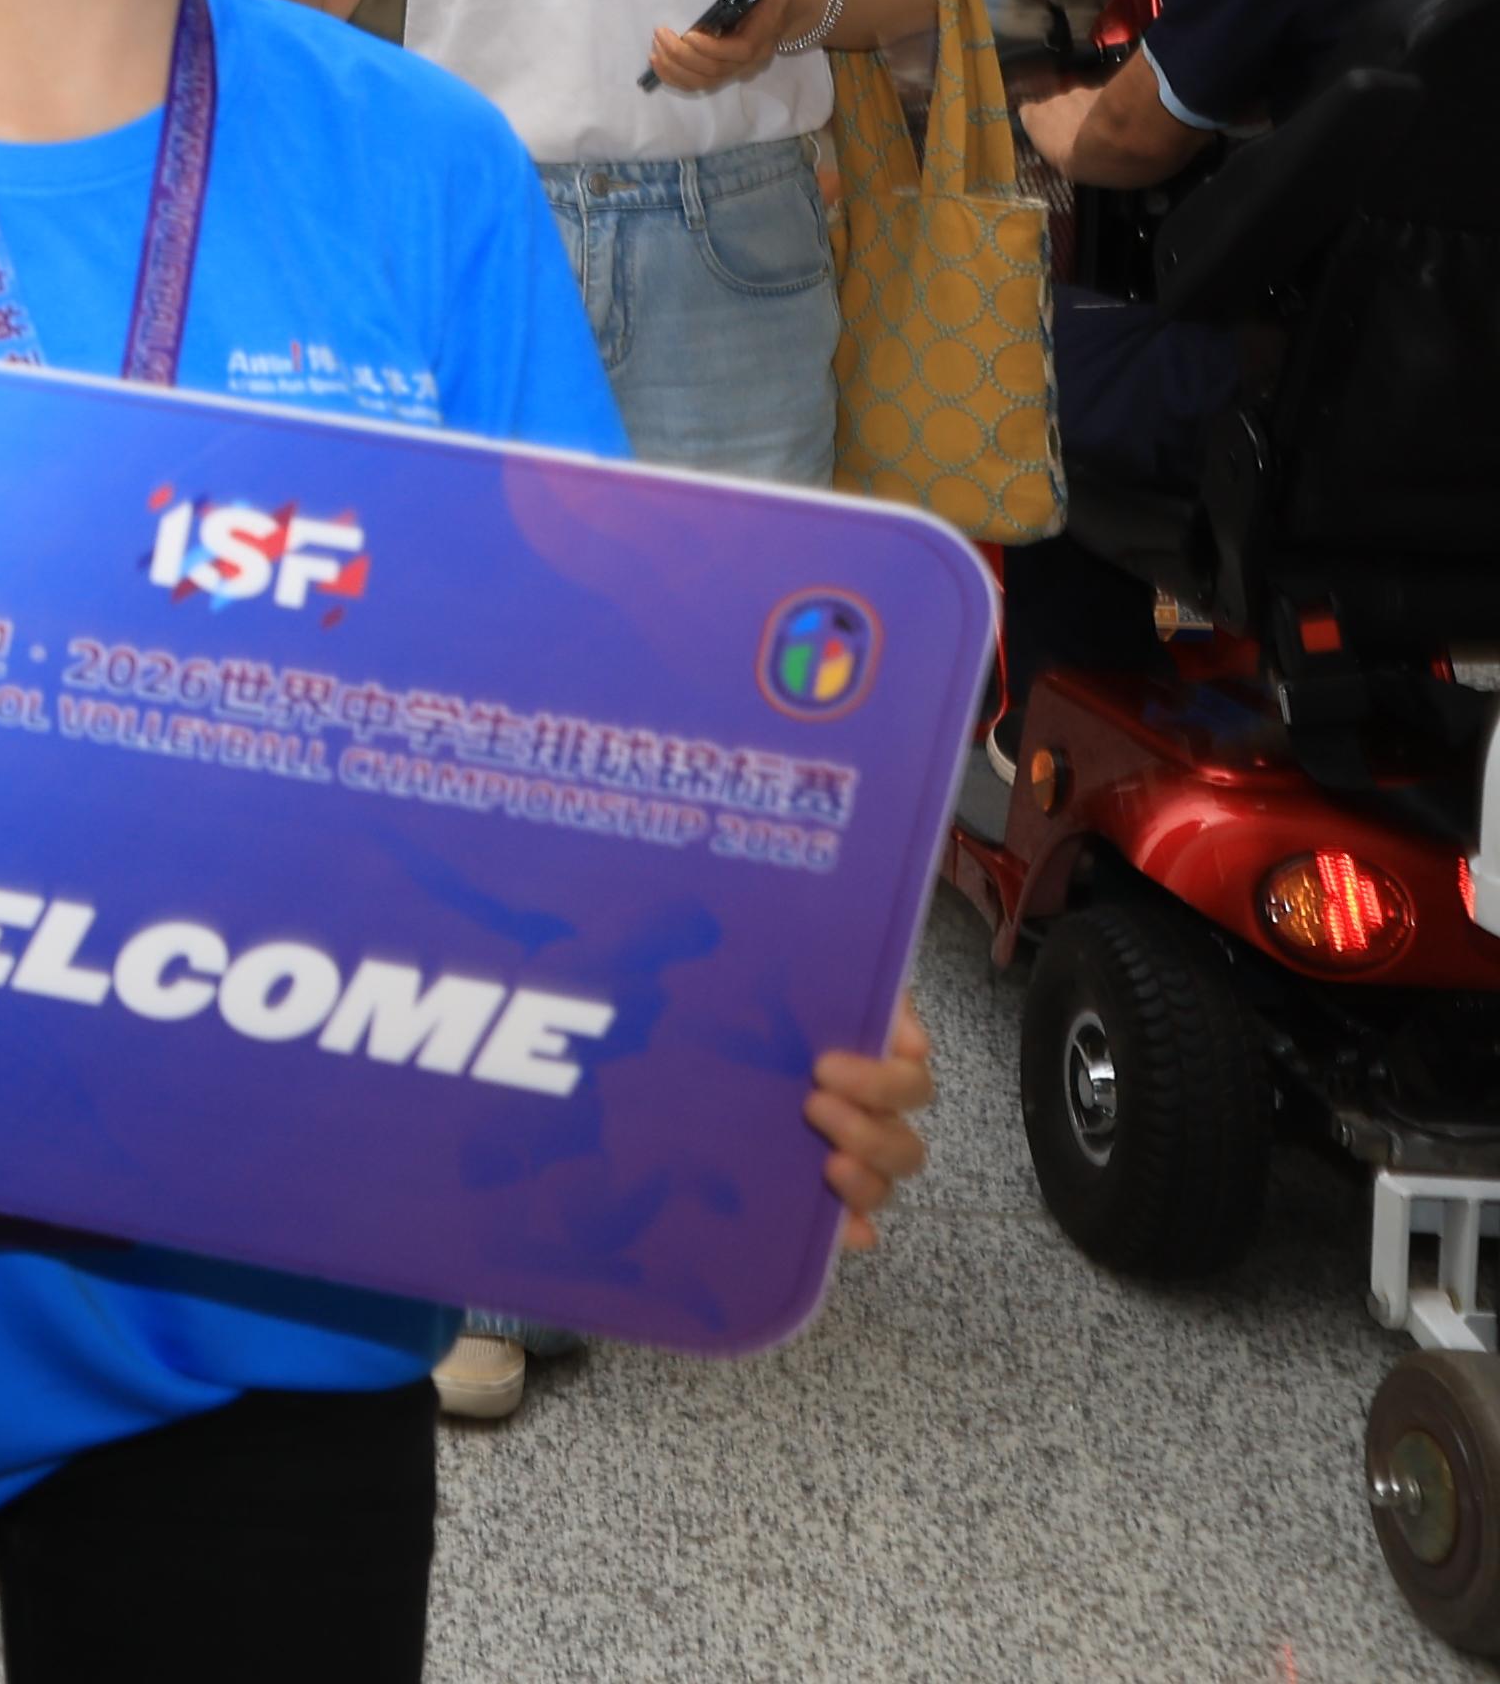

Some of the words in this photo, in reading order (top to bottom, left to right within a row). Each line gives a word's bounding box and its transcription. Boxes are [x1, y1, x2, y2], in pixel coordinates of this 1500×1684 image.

[147, 496, 366, 610] ISF
[56, 692, 333, 784] VOLLEYBALL
[339, 744, 708, 847] CHAMPIONSHIP
[710, 810, 841, 873] 2026
